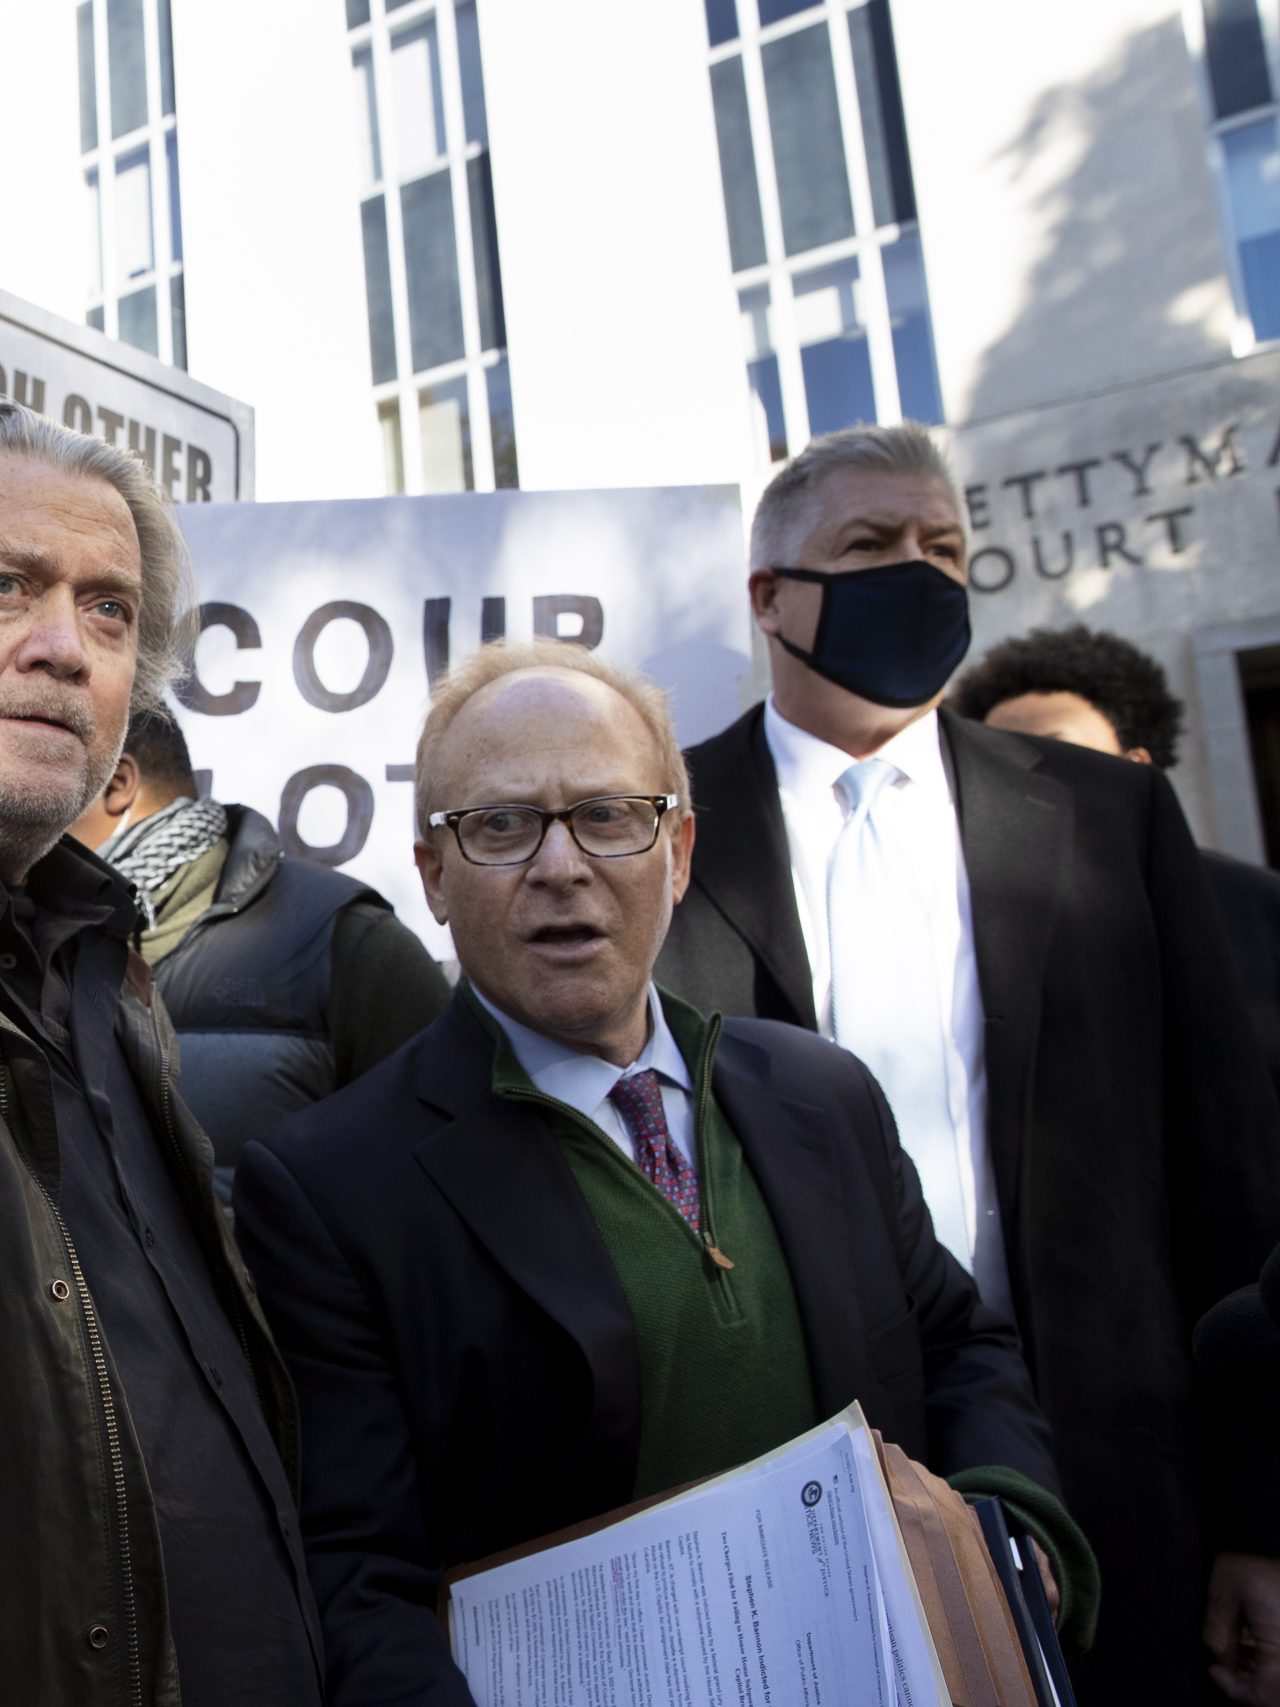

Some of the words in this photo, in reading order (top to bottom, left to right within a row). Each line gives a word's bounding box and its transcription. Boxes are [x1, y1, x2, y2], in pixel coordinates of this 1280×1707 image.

[820, 1568, 829, 1597] JUSTICE
[744, 1574, 756, 1608] Stephen
[751, 1621, 763, 1653] Bannon
[757, 1655, 769, 1689] Indicted
[763, 1691, 771, 1704] for
[805, 1632, 816, 1670] Department
[811, 1671, 817, 1679] of
[893, 1649, 907, 1681] politics
